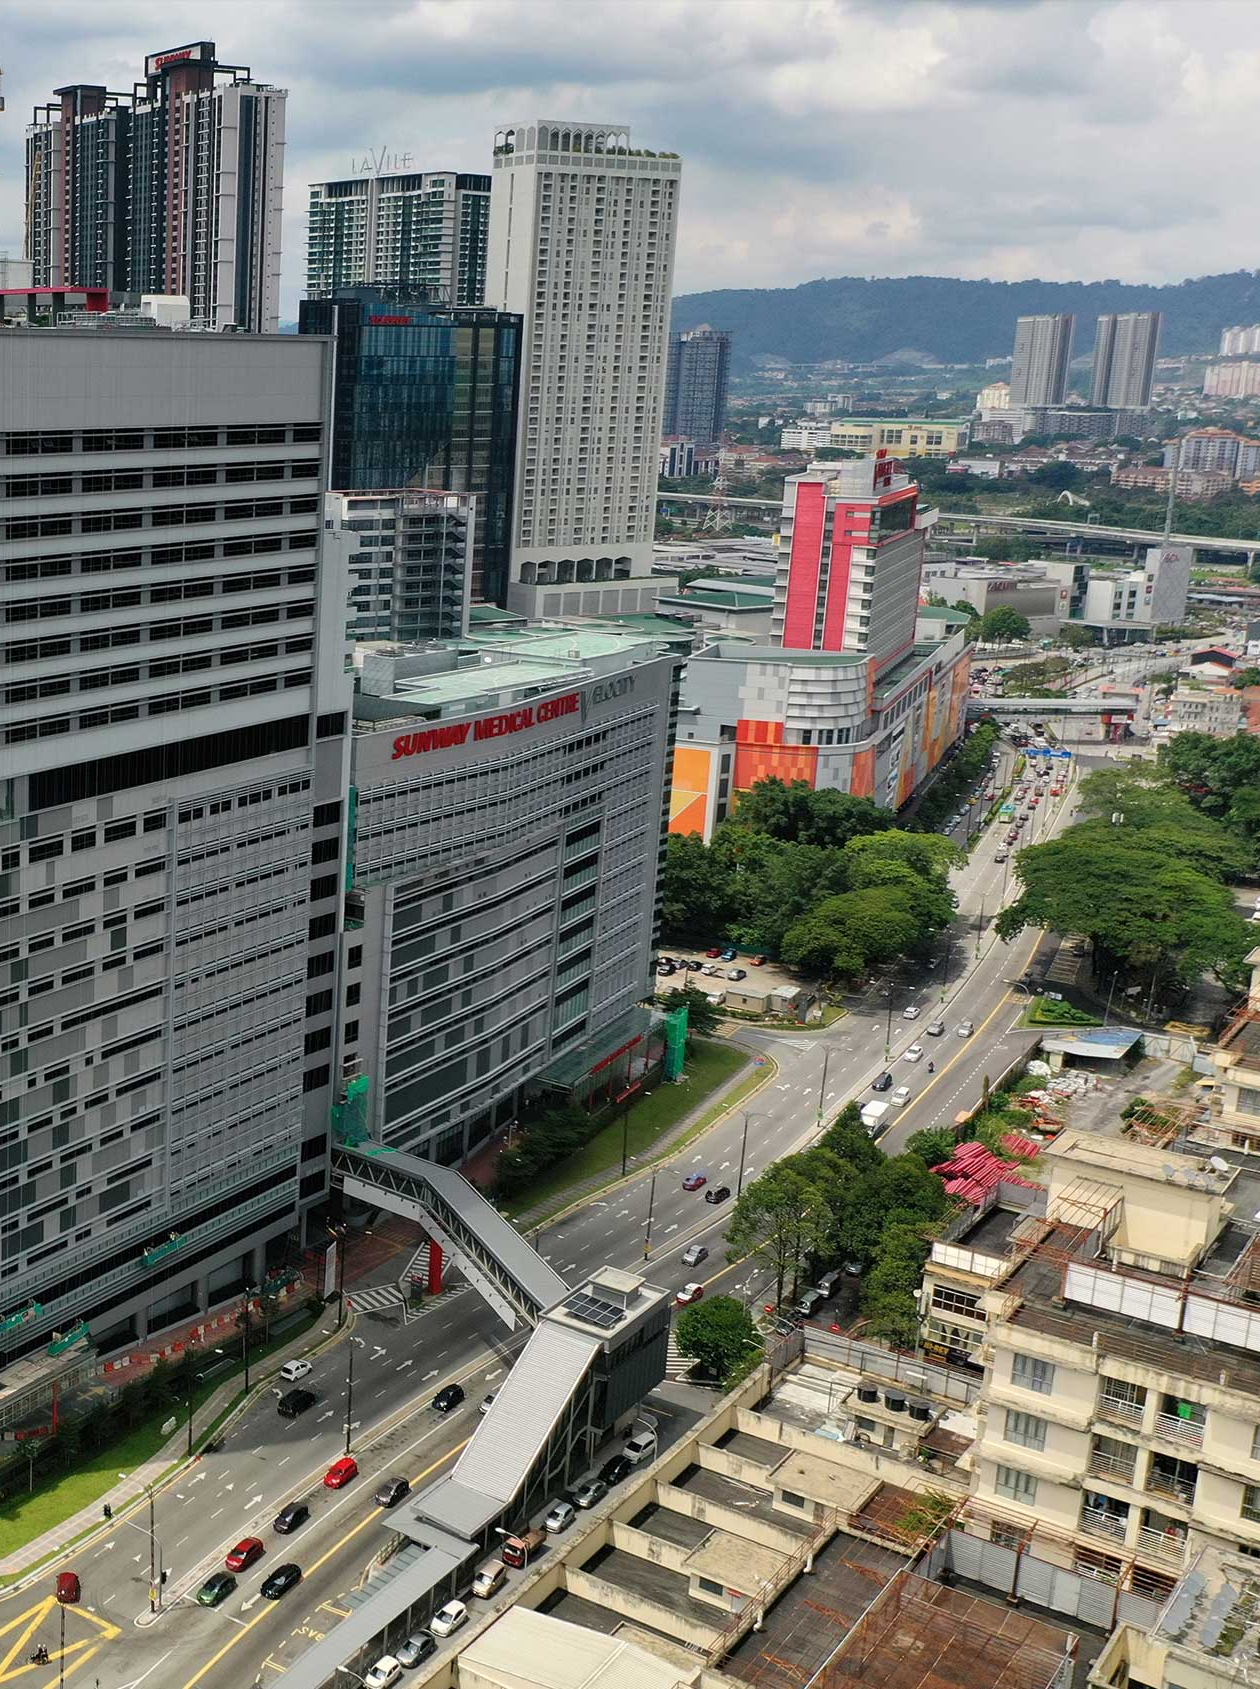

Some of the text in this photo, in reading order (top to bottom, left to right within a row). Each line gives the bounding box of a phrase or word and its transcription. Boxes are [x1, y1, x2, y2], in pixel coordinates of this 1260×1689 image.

[391, 675, 637, 760] SUNWAY MEDICAL CENTRE VELOCITY
